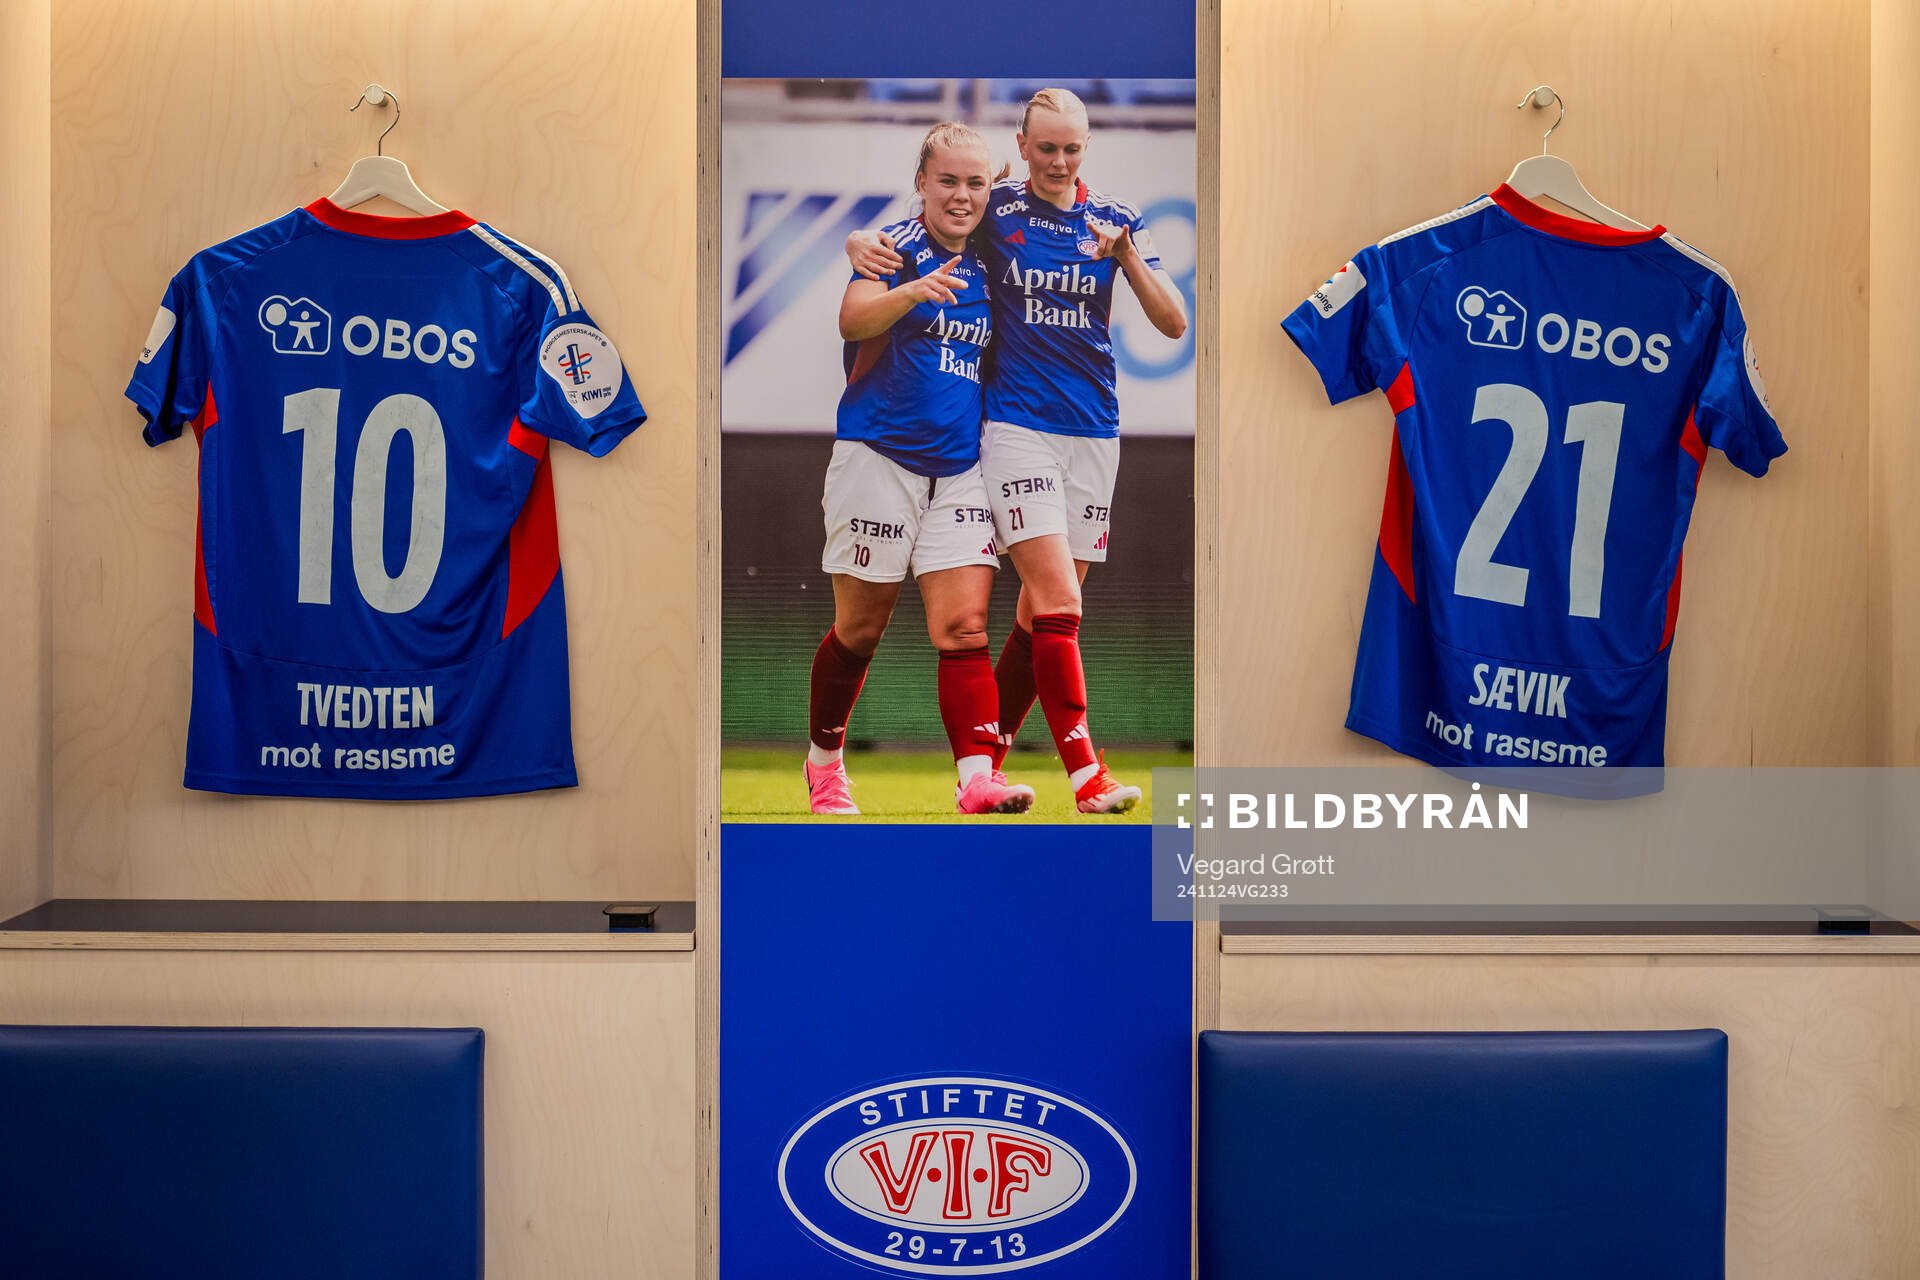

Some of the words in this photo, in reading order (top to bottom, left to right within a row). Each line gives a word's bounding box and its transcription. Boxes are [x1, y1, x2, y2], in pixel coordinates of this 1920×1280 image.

[1002, 257, 1096, 295] Aprila
[924, 308, 992, 347] Aprila
[1024, 298, 1092, 329] Bank
[342, 315, 477, 369] OBOS
[1536, 312, 1671, 374] OBOS
[581, 388, 602, 402] KIWI
[282, 388, 447, 614] 10
[954, 508, 993, 524] STER
[1008, 506, 1025, 531] 21
[1083, 504, 1109, 522] STE
[1453, 383, 1626, 619] 21
[854, 543, 871, 568] 10
[297, 682, 434, 729] TVEDTEN
[1469, 663, 1571, 719] SÆVIK
[261, 741, 321, 769] mot
[334, 743, 455, 770] rasisme
[1425, 709, 1474, 752] mot
[1485, 731, 1607, 769] rasisme
[859, 1089, 1057, 1126] STIFTET
[884, 1231, 1027, 1262] 29-7-13
